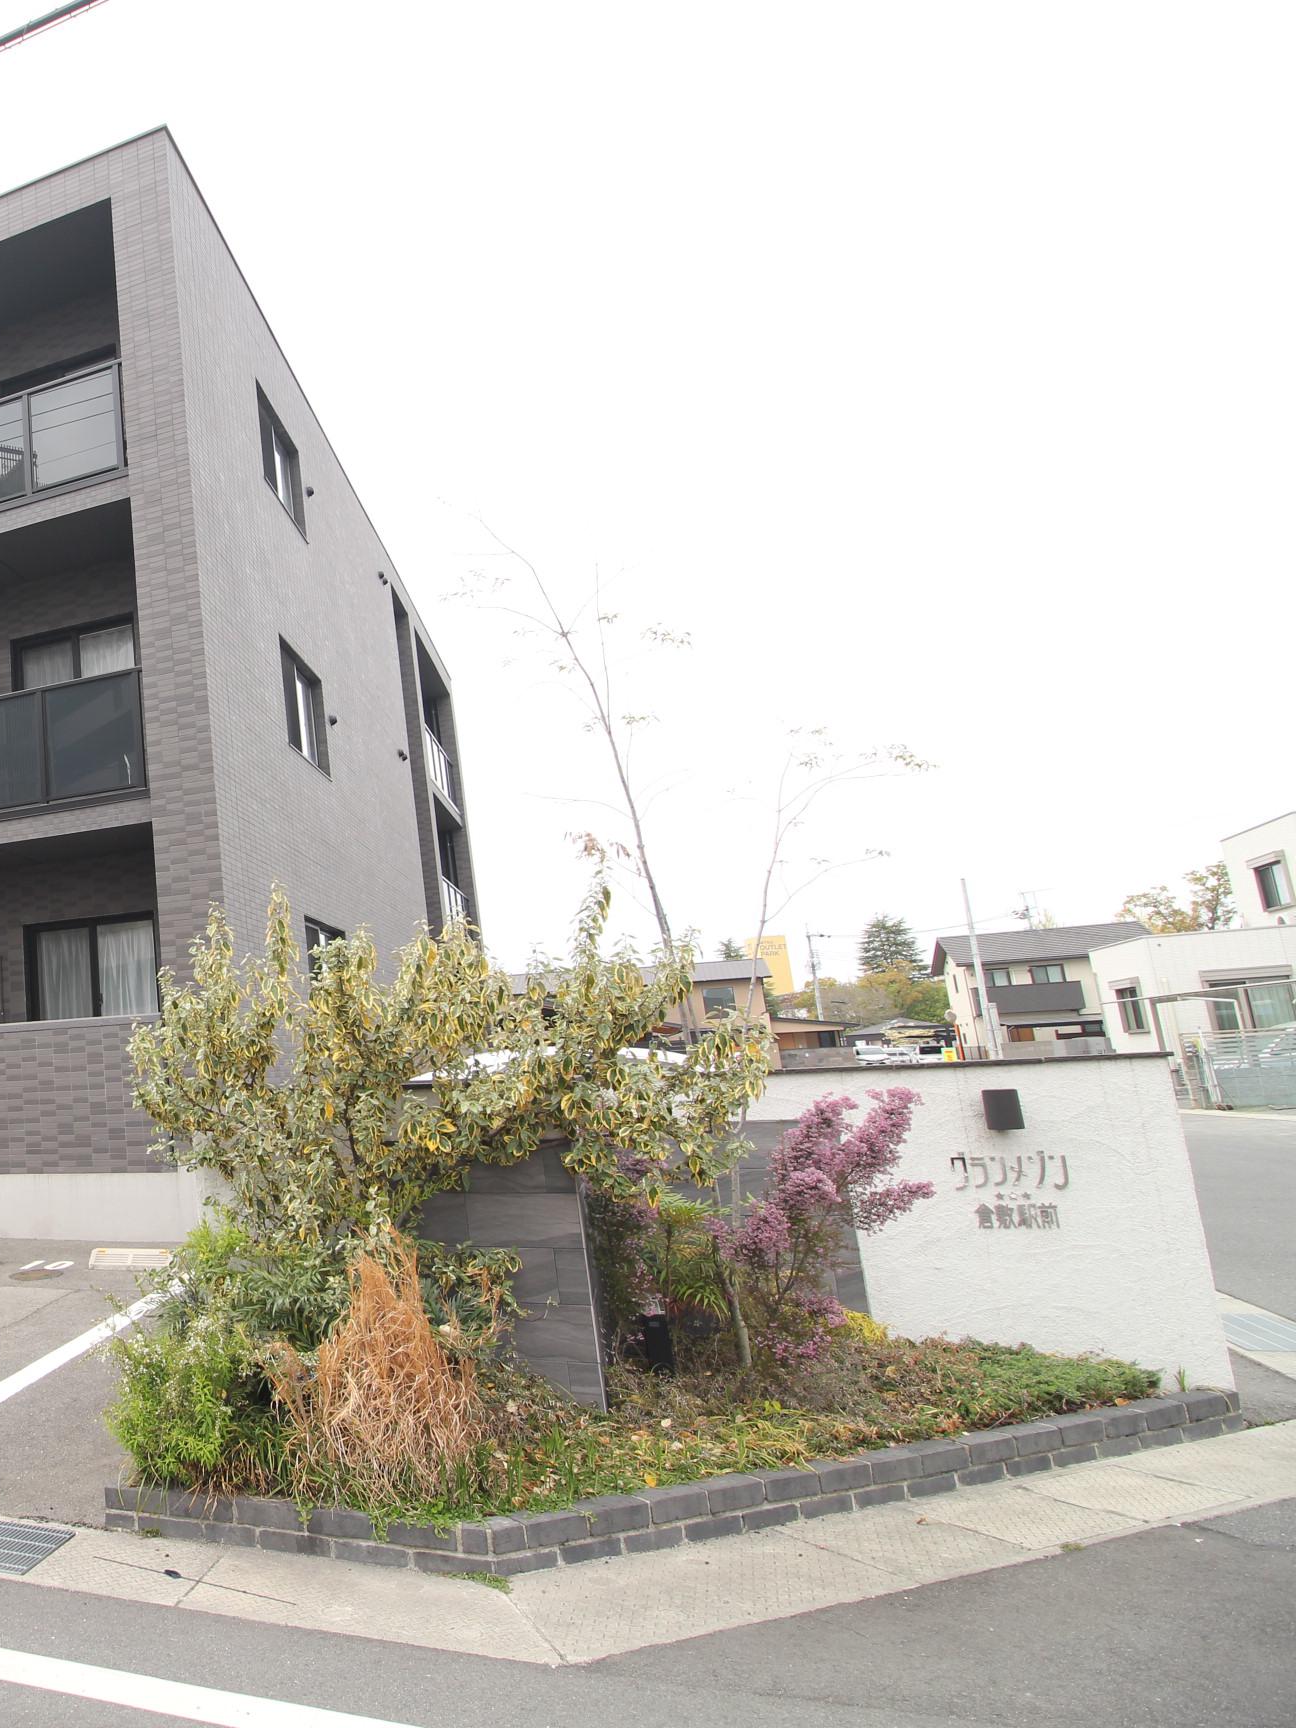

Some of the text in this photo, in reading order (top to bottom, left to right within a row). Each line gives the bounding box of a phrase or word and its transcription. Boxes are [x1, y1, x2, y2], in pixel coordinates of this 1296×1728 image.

[950, 1150, 1070, 1191] グランメゾン
[974, 1202, 1061, 1230] 倉敷駅前
[18, 1260, 75, 1270] 10
